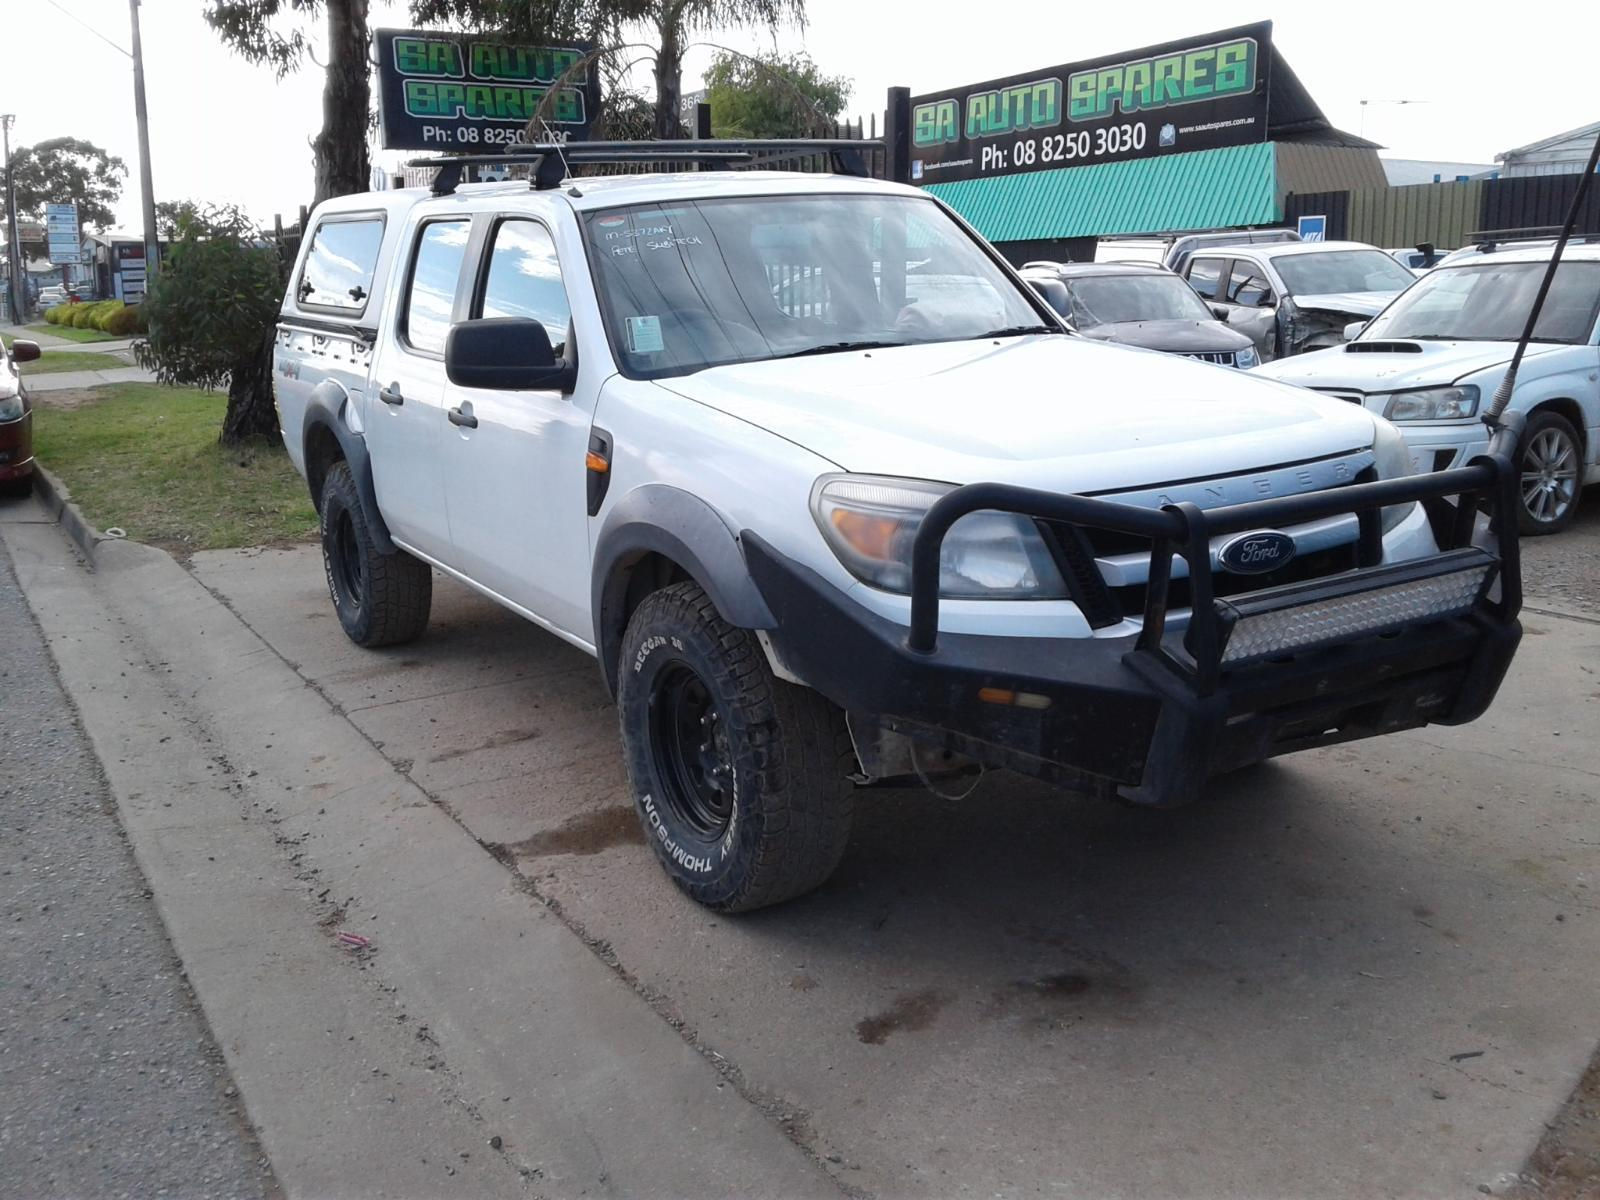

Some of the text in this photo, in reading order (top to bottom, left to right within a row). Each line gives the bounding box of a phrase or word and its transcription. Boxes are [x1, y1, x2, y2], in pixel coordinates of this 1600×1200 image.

[397, 39, 582, 82] SA AUTO
[406, 82, 578, 120] SPARES
[915, 42, 1248, 144] SA AUTO SPARES
[422, 126, 452, 142] Ph:
[457, 127, 479, 143] 08
[484, 128, 525, 144] 8250
[981, 121, 1147, 171] Ph: 08 8250 3030
[1240, 538, 1280, 563] Ford
[642, 793, 712, 873] THOMPSON
